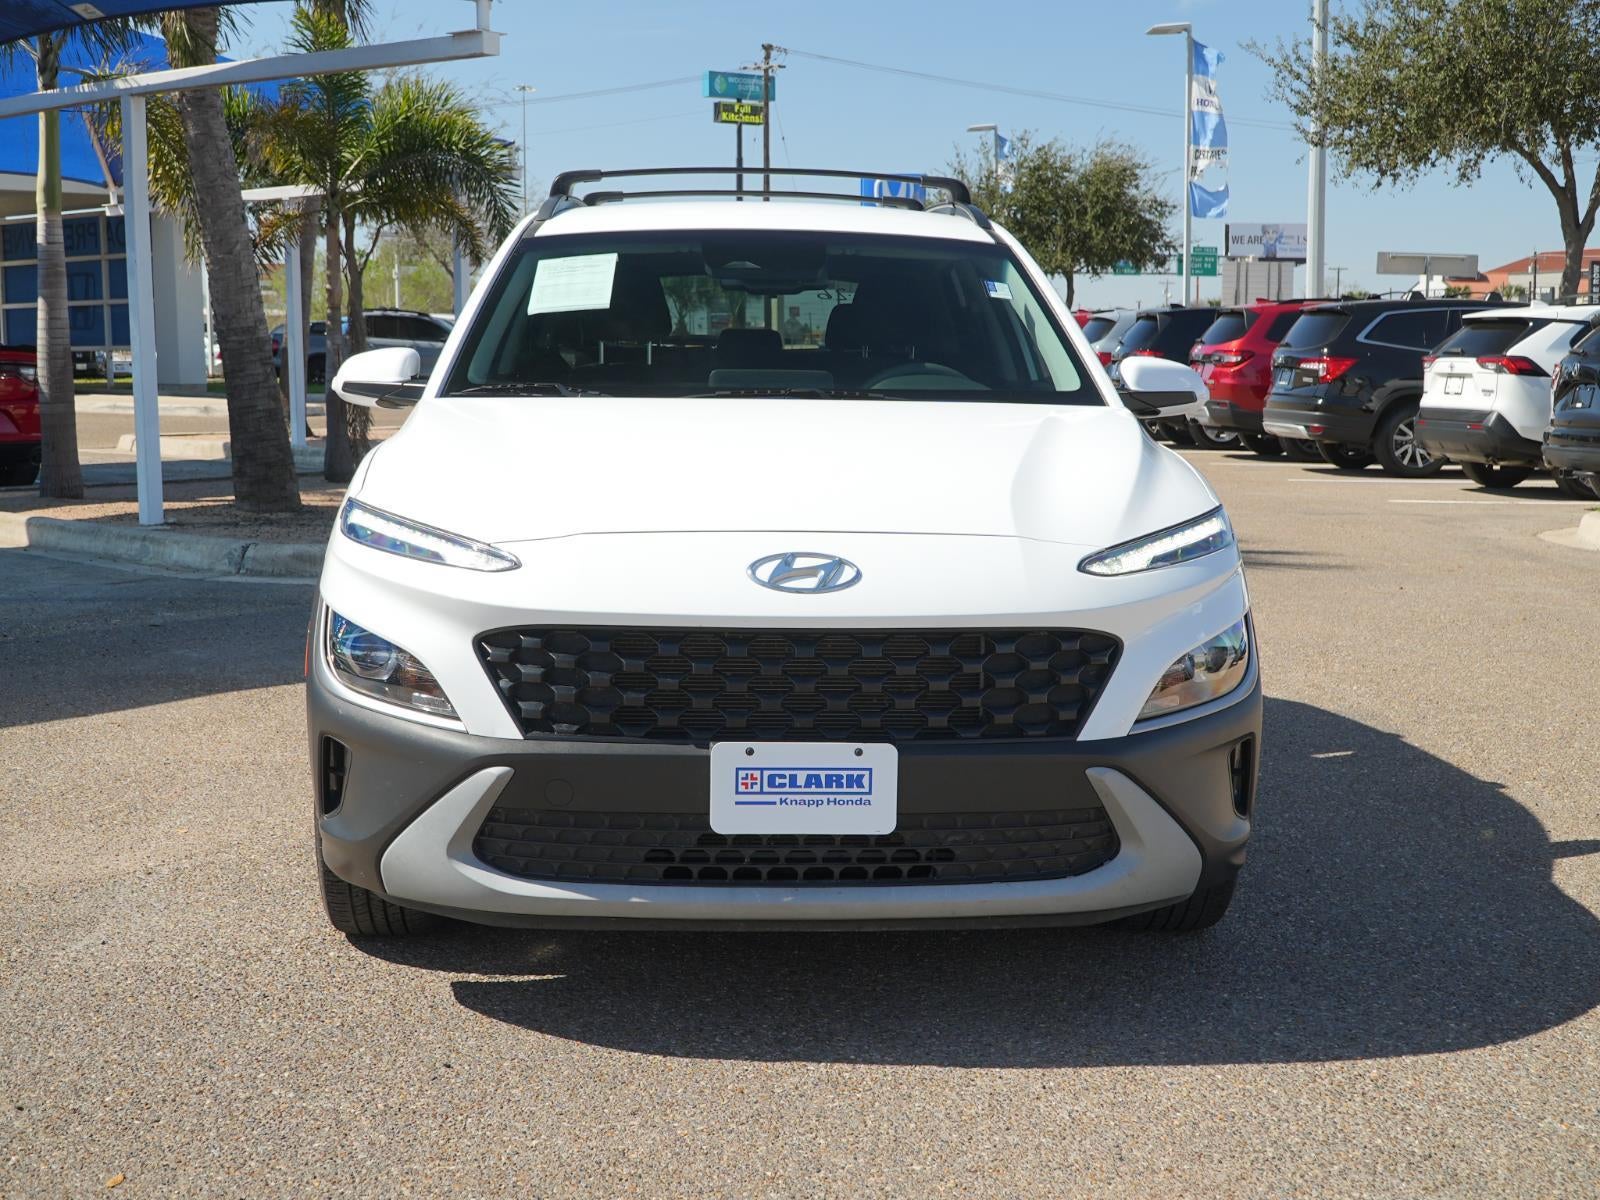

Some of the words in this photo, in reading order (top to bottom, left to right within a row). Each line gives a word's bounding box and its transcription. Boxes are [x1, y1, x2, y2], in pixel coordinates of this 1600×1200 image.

[735, 104, 752, 113] Full
[1231, 235, 1246, 244] WE
[767, 773, 866, 789] CLARK
[779, 797, 824, 807] Knapp
[826, 797, 872, 806] Honda
